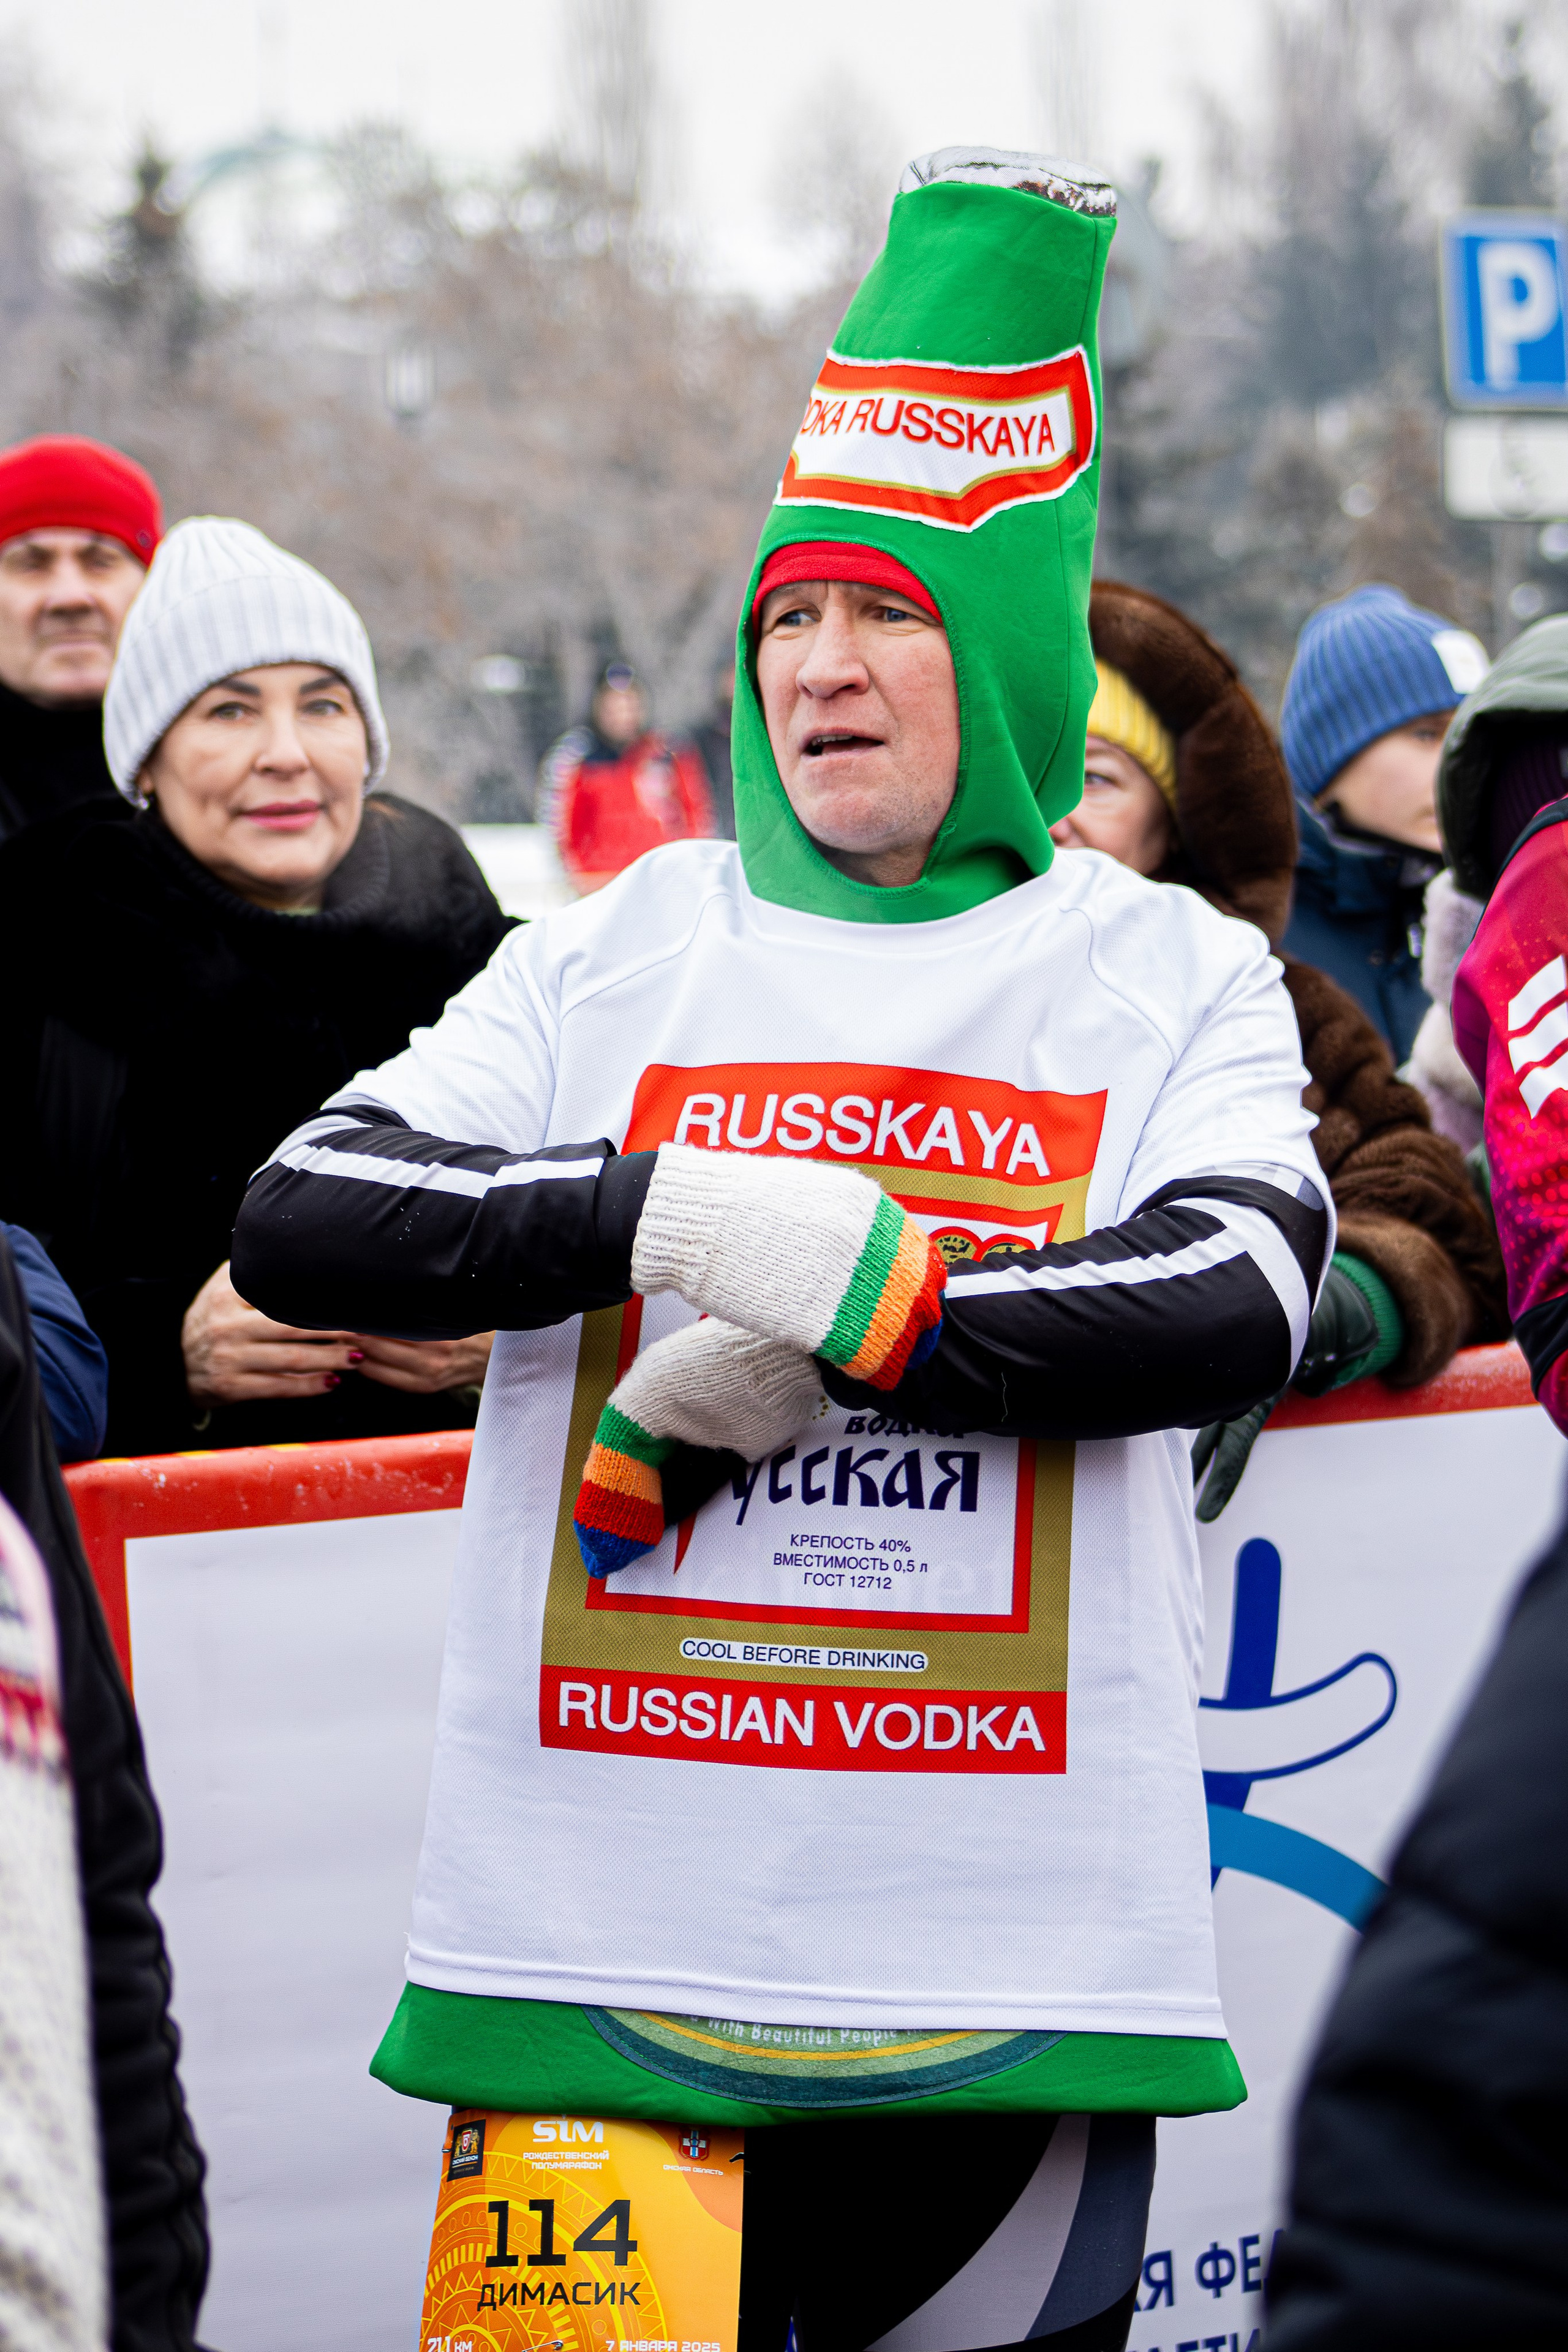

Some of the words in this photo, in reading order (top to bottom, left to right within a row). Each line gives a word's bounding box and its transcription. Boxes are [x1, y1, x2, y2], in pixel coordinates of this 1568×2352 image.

[1477, 243, 1559, 389] P
[799, 396, 848, 436] DKA
[845, 397, 1055, 458] RUSSKAYA
[674, 1093, 1050, 1177] RUSSKAYA
[731, 1444, 980, 1526] усская
[790, 1534, 875, 1550] КРЕПОСТЬ
[878, 1539, 911, 1552] 40%
[773, 1553, 889, 1571] ВМЕСТИМОСТЬ
[893, 1559, 915, 1574] 0,5
[919, 1562, 928, 1572] л
[804, 1572, 845, 1586] ГОСТ
[850, 1575, 892, 1589] 12712
[682, 1640, 737, 1659] COOL
[742, 1645, 821, 1665] BEFORE
[827, 1650, 925, 1670] DRINKING
[558, 1681, 815, 1747] RUSSIAN
[834, 1700, 1047, 1752] VODKA
[751, 2022, 832, 2046] Beautiful
[523, 2149, 609, 2161] РОЖДЕСТВЕНСКИЙ
[531, 2161, 602, 2170] ПОЛУМАРАФОН
[692, 2167, 723, 2176] ОБЛАСТЬ
[485, 2199, 637, 2267] 114
[1134, 2250, 1175, 2312] Я
[1195, 2229, 1284, 2299] ФЕ
[477, 2282, 641, 2312] ДИМАСИК
[605, 2340, 615, 2351] 7
[619, 2340, 677, 2352] ЯНВАРЯ
[681, 2341, 721, 2352] 2025
